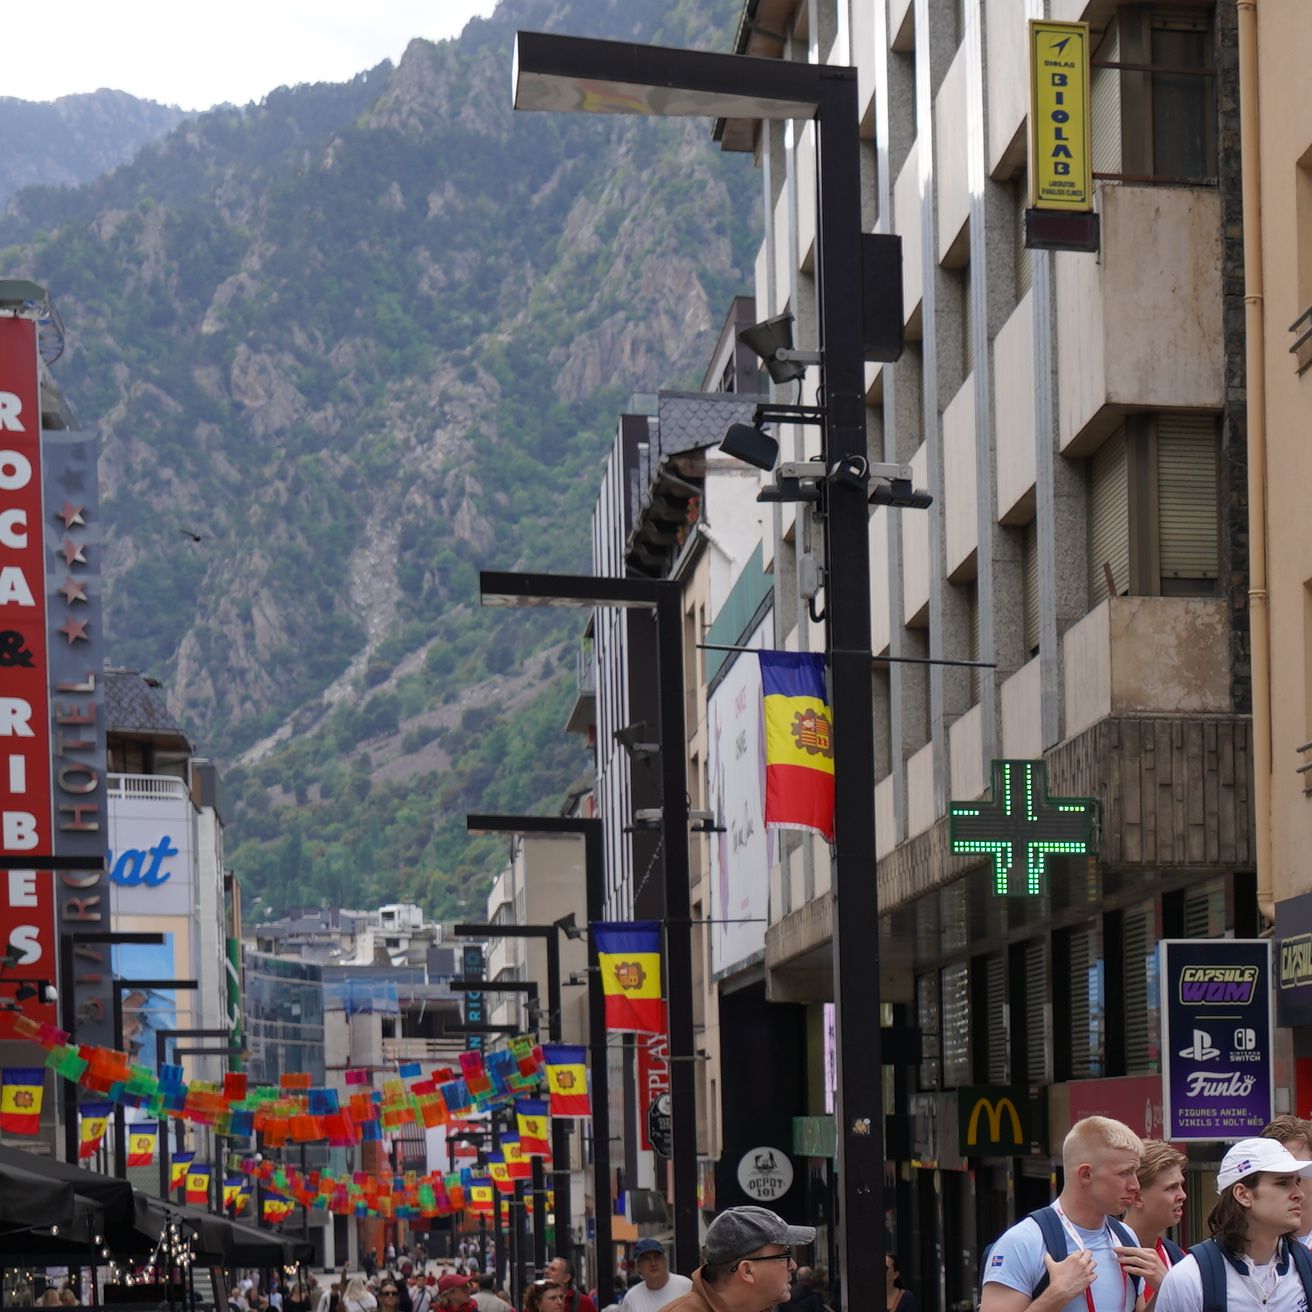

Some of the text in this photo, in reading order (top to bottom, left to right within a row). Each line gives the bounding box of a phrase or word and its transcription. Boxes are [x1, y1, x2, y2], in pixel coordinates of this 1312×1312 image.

[1051, 73, 1073, 176] BIOLAB
[0, 391, 42, 965] ROCA & RIBES
[56, 671, 99, 832] HOTEL
[1183, 969, 1255, 982] CAPSULE
[1186, 1071, 1254, 1097] Funko
[1178, 1108, 1218, 1117] FIGURES
[1178, 1114, 1264, 1127] VINILS I MOLT MÉS
[749, 1177, 784, 1190] DEPOT
[757, 1187, 776, 1197] 101
